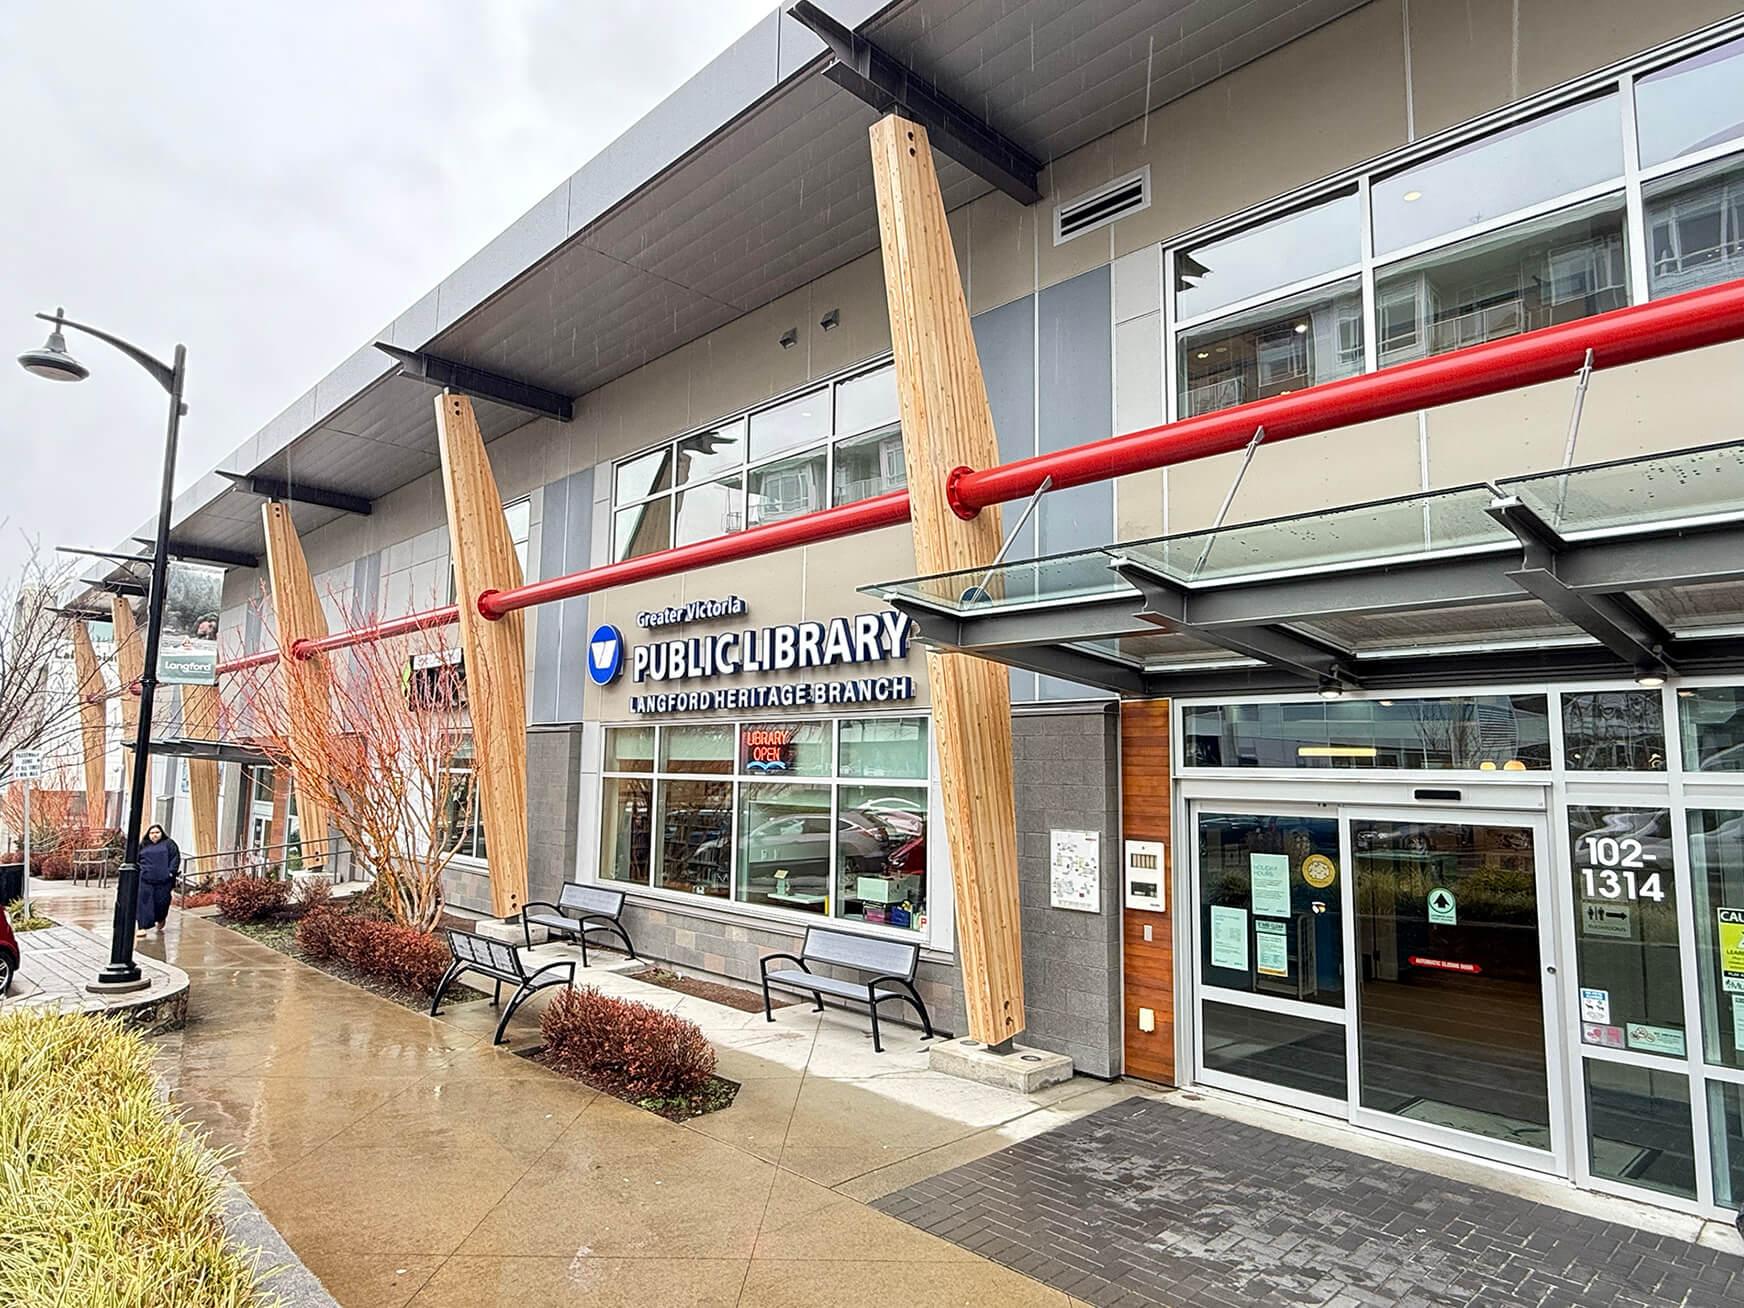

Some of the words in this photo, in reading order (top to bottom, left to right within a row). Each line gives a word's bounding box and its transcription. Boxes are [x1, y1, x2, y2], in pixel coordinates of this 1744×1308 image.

[636, 607, 686, 628] Greater
[685, 595, 747, 621] Victoria
[633, 632, 739, 682] PUBLIC
[743, 611, 911, 672] LIBRARY
[165, 660, 211, 673] Langford
[629, 691, 712, 714] LANGFORD
[714, 684, 808, 711] HERITAGE
[814, 676, 912, 704] BRANCH
[747, 730, 788, 746] LIBRARY
[753, 747, 781, 761] OPEN
[1585, 837, 1656, 868] 102-
[1582, 868, 1664, 902] 1314
